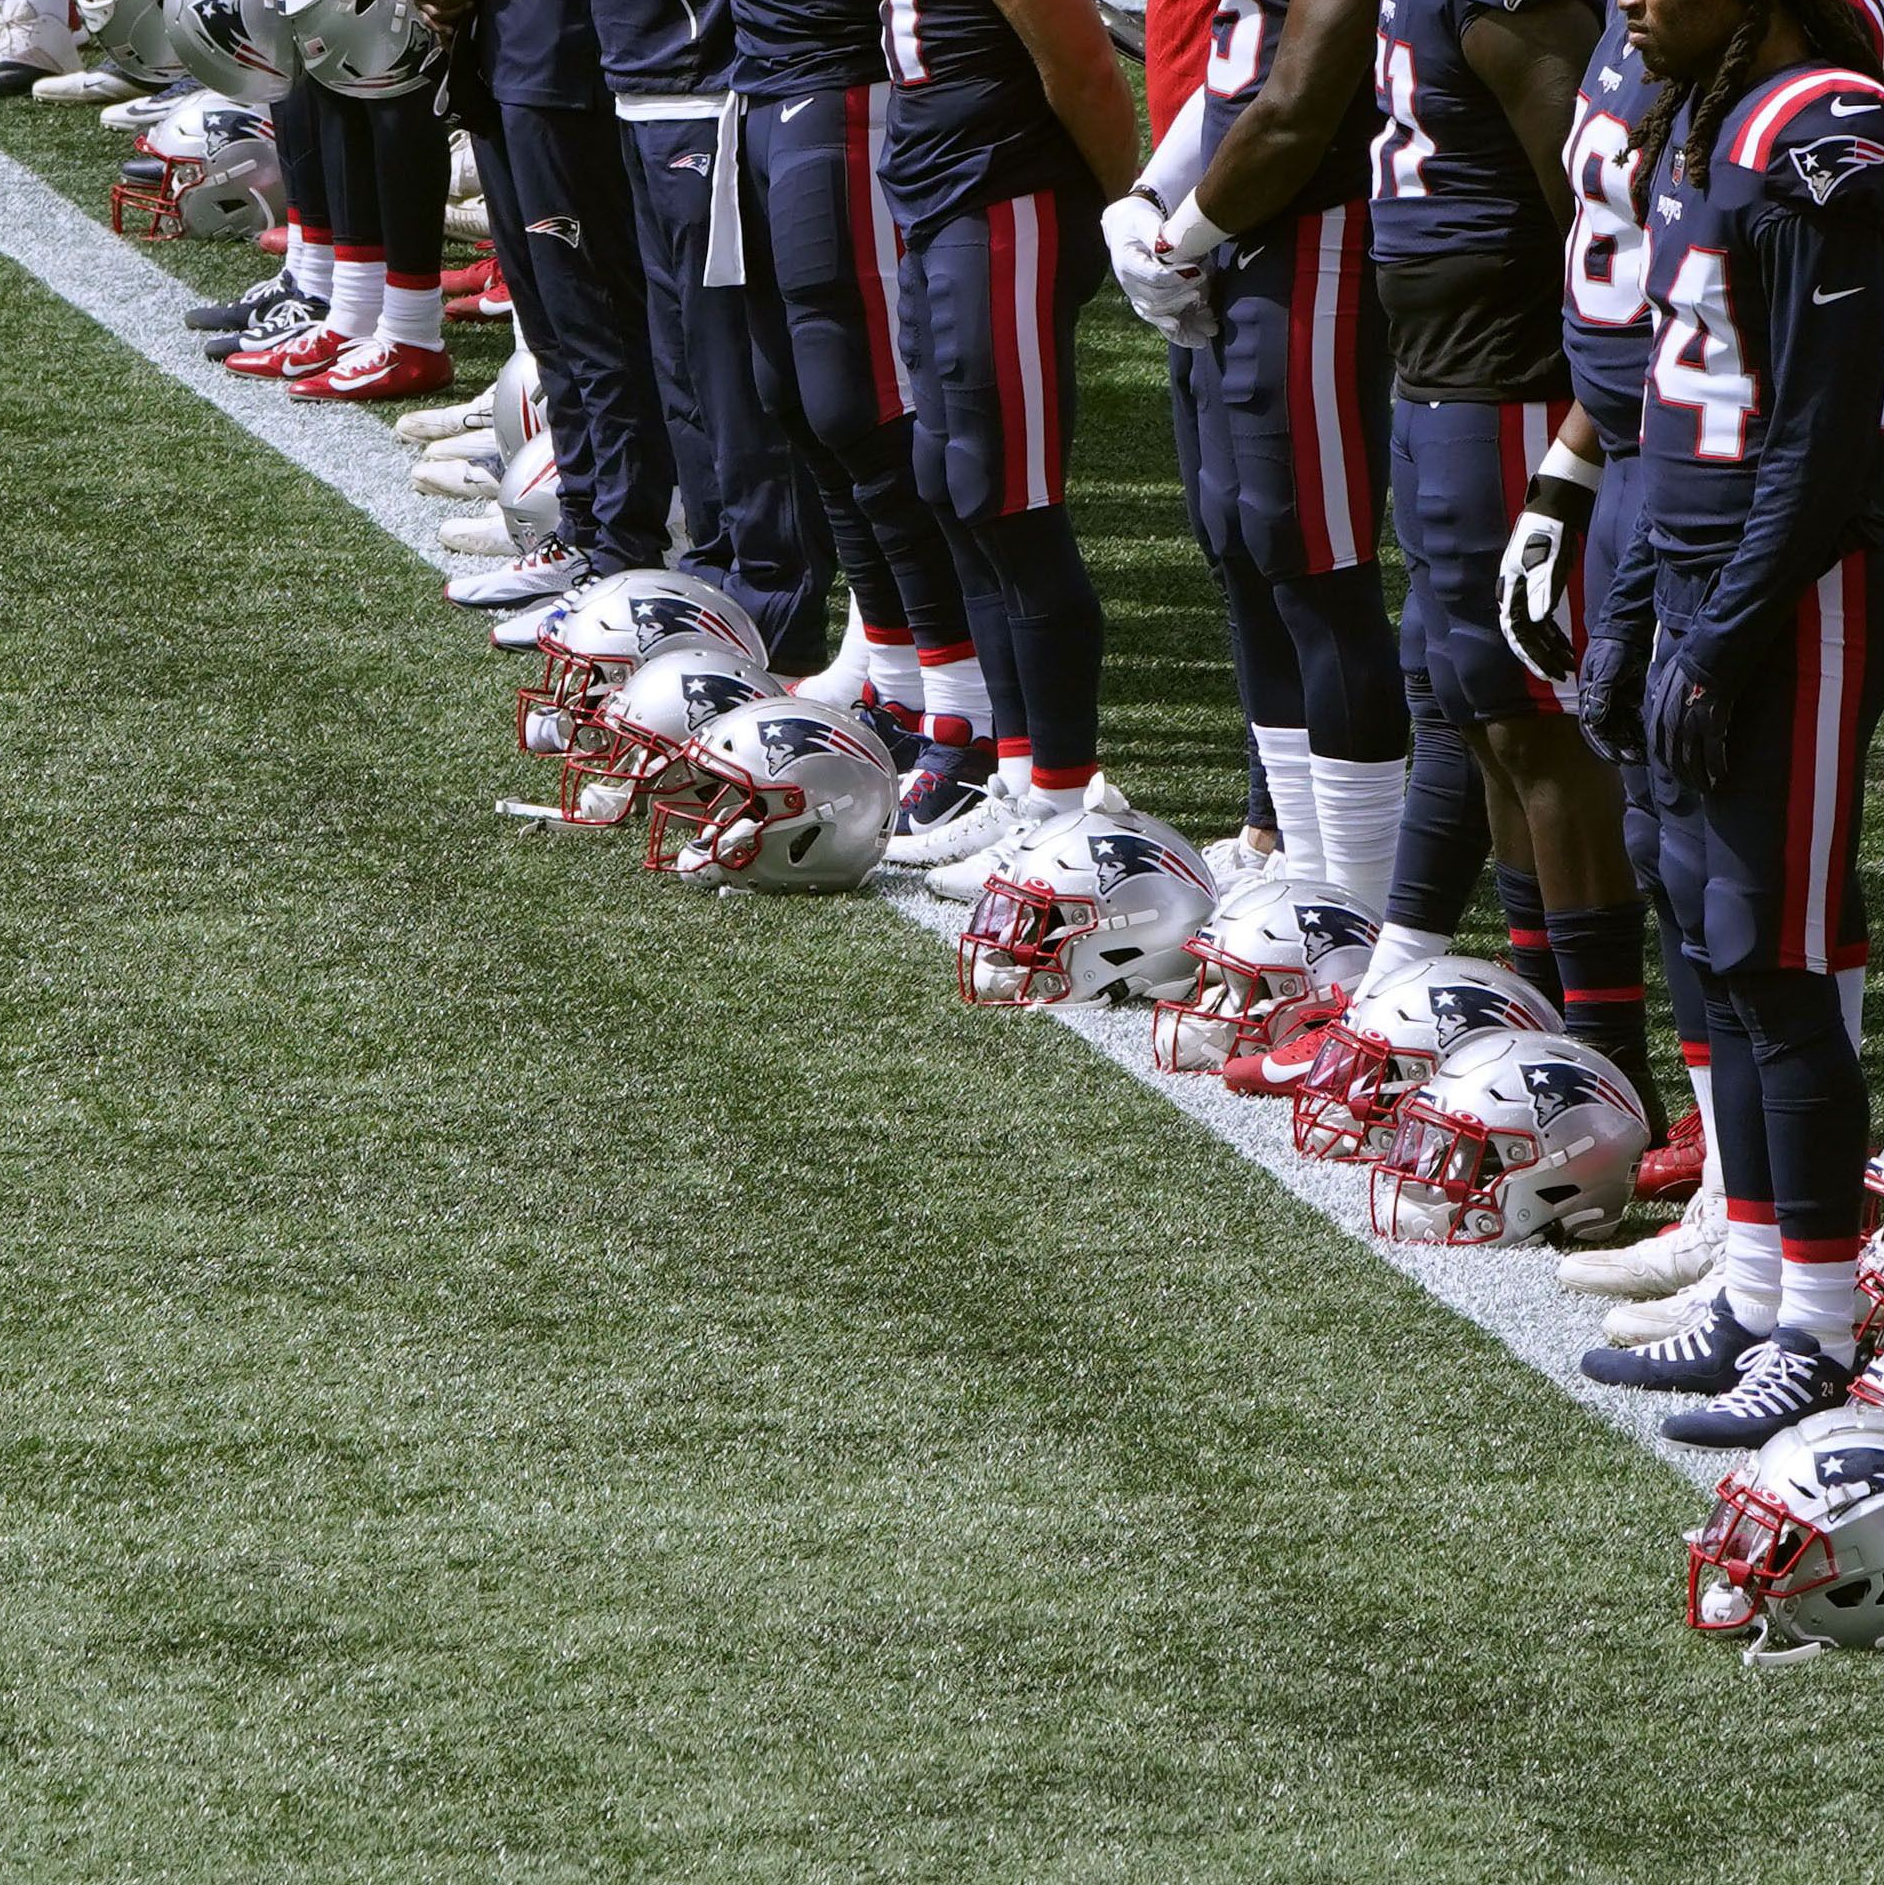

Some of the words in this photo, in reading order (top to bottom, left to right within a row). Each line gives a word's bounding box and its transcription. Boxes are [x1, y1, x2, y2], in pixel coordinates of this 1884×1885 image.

[1561, 88, 1655, 330] 8
[1639, 222, 1759, 463] 4
[1820, 1380, 1835, 1398] 24
